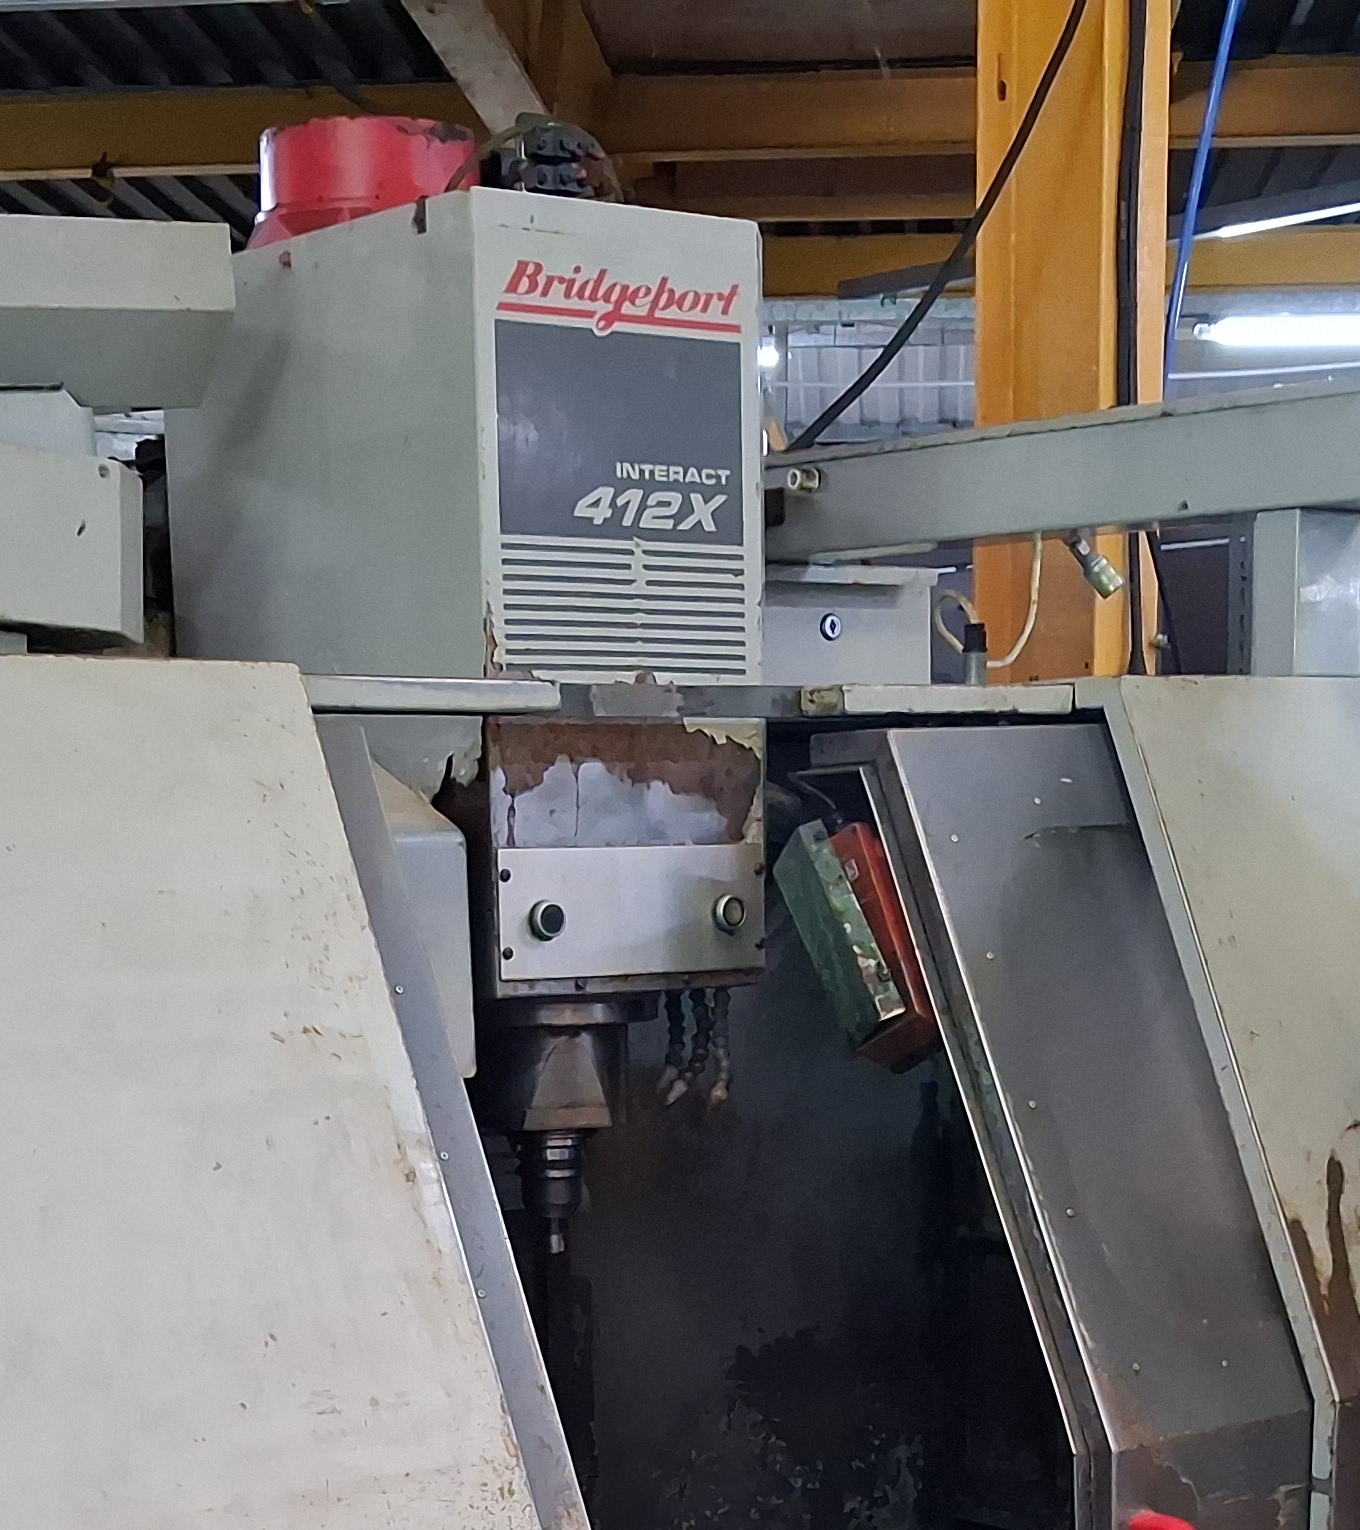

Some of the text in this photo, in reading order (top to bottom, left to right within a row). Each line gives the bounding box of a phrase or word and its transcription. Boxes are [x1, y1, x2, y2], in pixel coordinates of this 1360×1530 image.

[496, 260, 742, 333] Bridgeport
[616, 462, 731, 485] INTERACT
[573, 486, 728, 532] 412X
